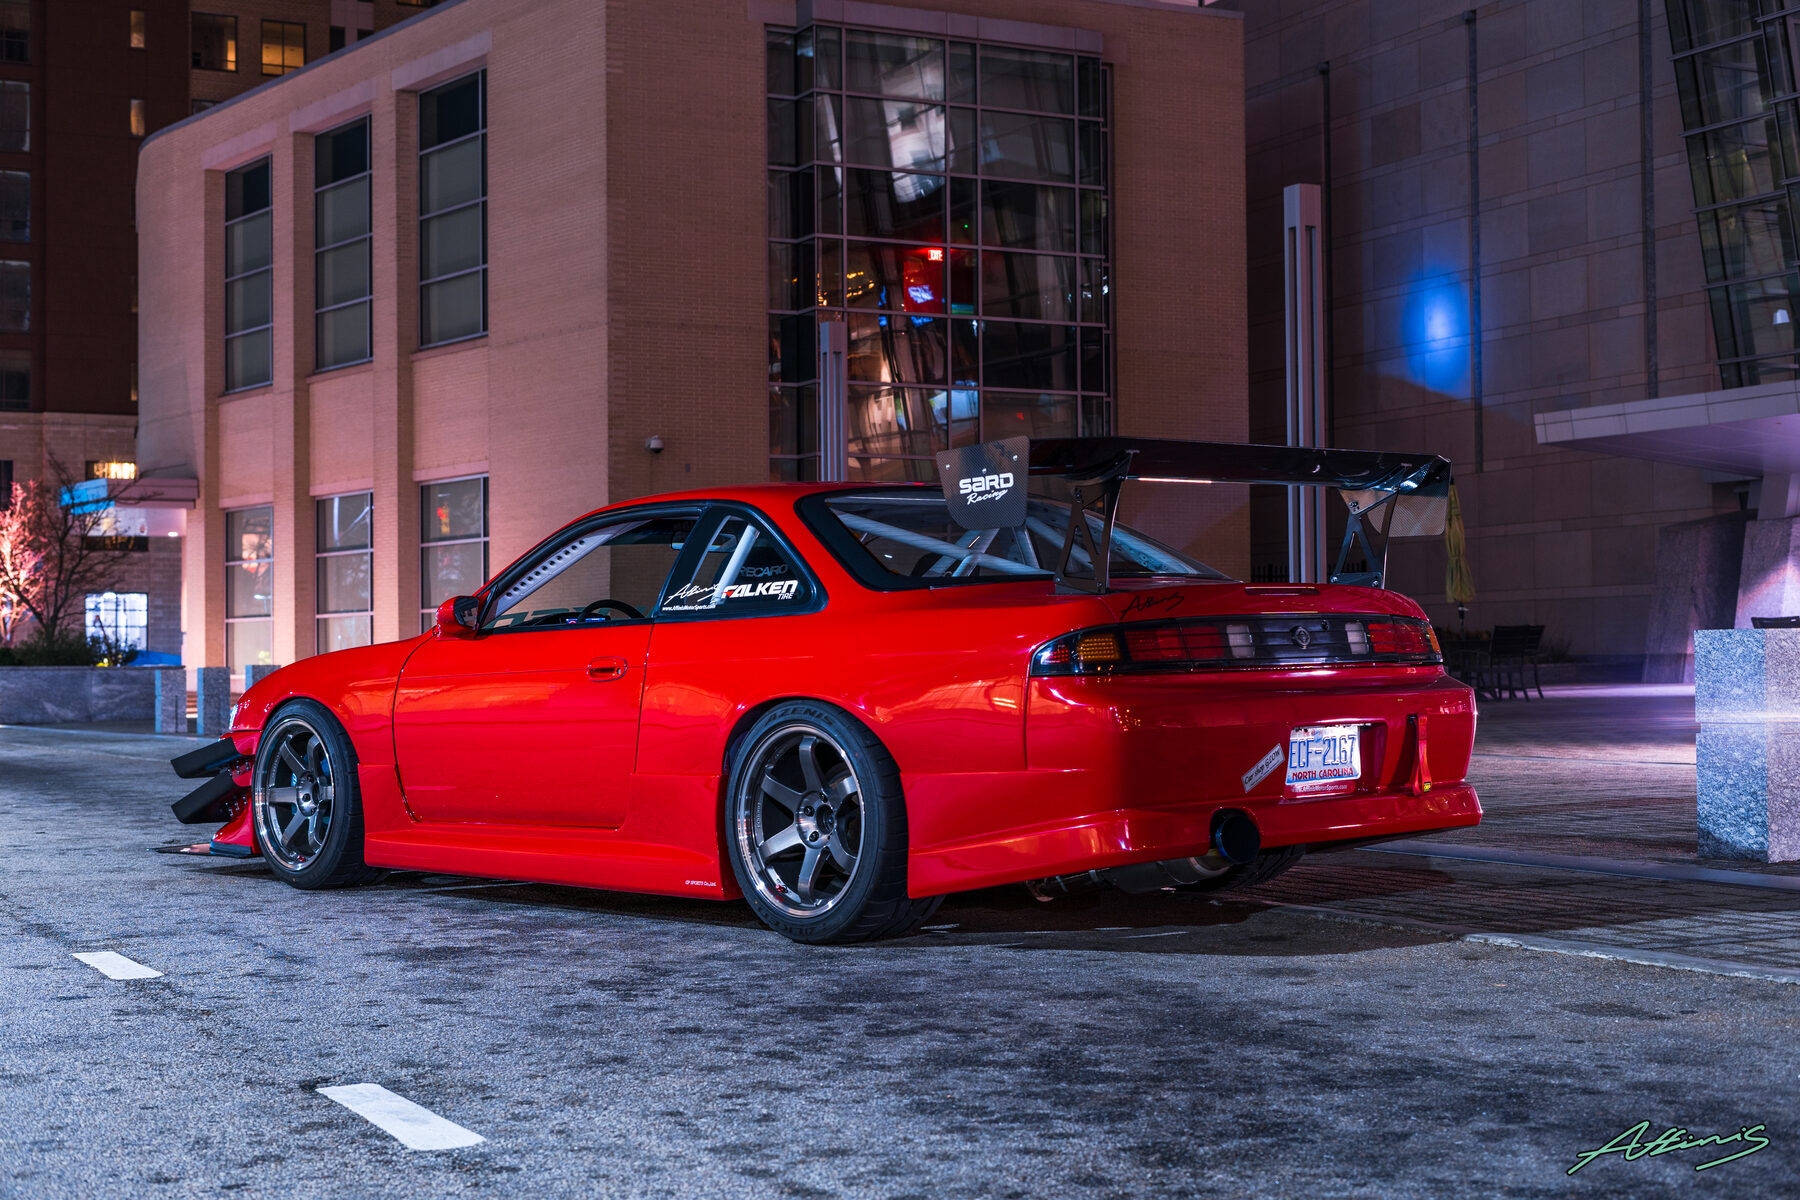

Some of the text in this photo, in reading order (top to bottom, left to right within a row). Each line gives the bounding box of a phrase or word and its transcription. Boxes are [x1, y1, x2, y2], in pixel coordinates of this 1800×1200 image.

[966, 489, 1008, 505] Racing
[738, 564, 788, 577] RECARO
[722, 580, 798, 599] FALKEN
[777, 592, 794, 600] TIRE
[1289, 735, 1357, 769] ECF-2167
[1292, 769, 1317, 781] NORTH
[1318, 767, 1354, 778] CAROLINA
